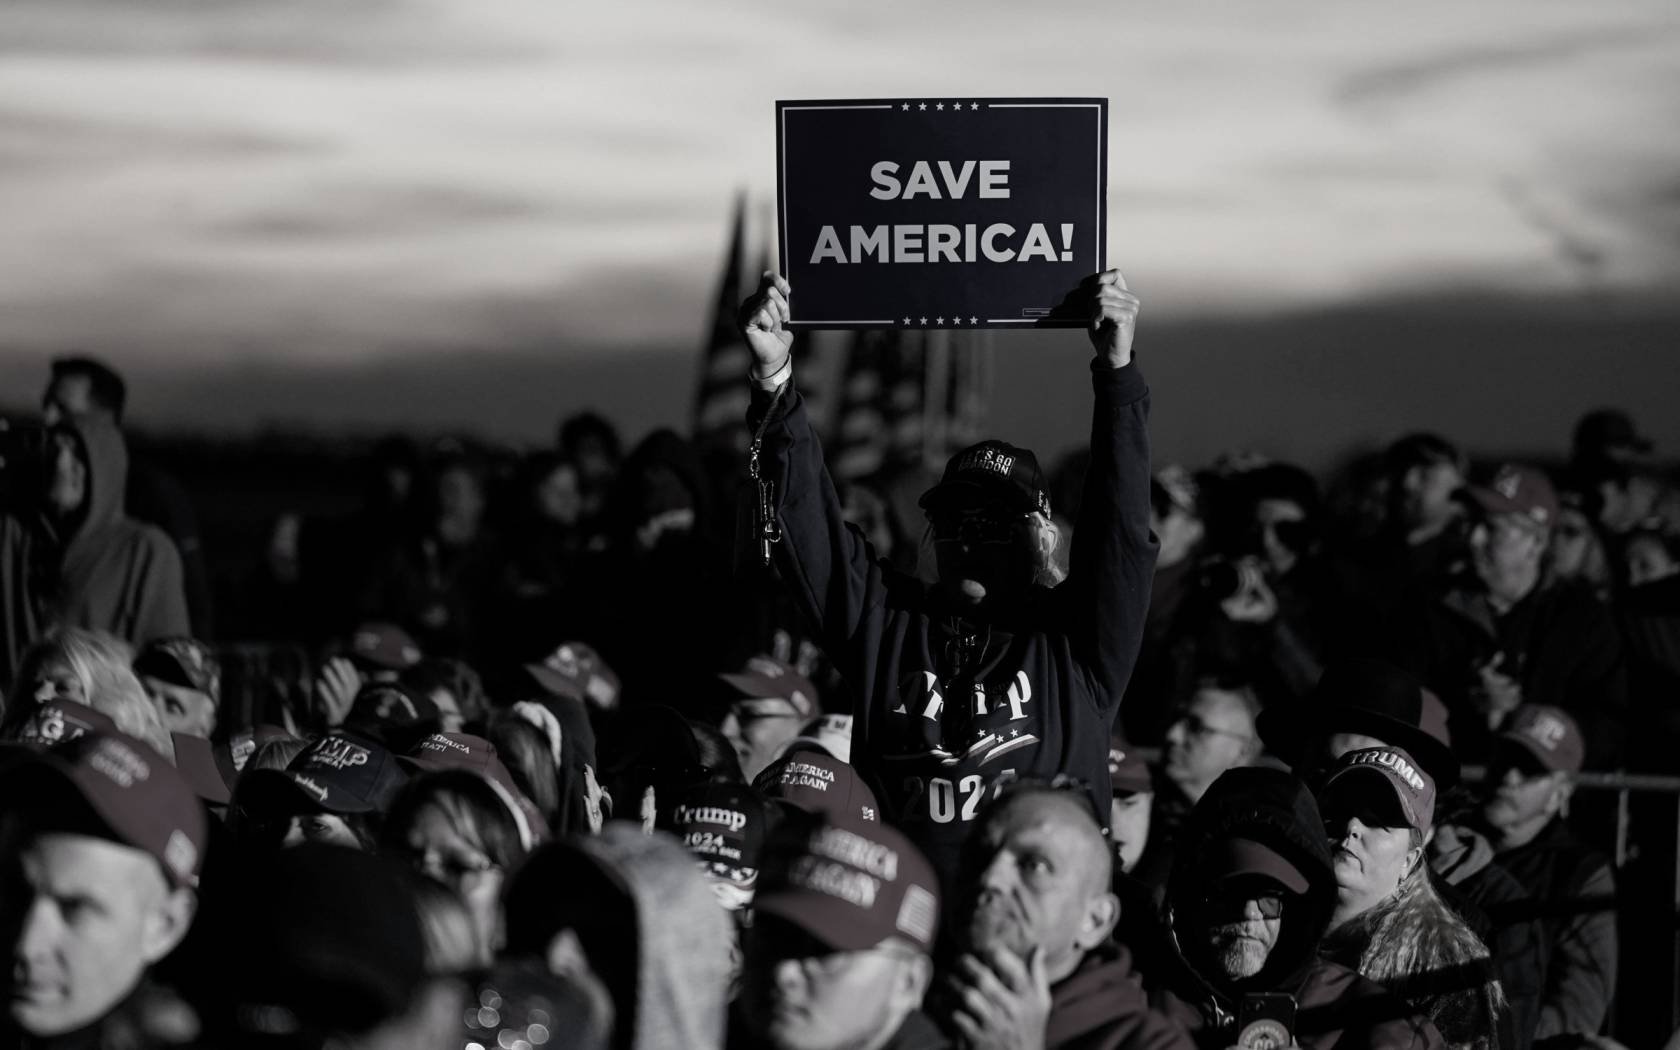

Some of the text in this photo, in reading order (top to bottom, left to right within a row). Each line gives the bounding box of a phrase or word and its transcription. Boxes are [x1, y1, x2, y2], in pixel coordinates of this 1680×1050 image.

[869, 160, 1011, 201] SAVE
[809, 223, 1074, 264] AMERICA!
[996, 454, 1013, 467] GO
[789, 775, 829, 791] AGAIN
[1349, 750, 1425, 790] TRUMP
